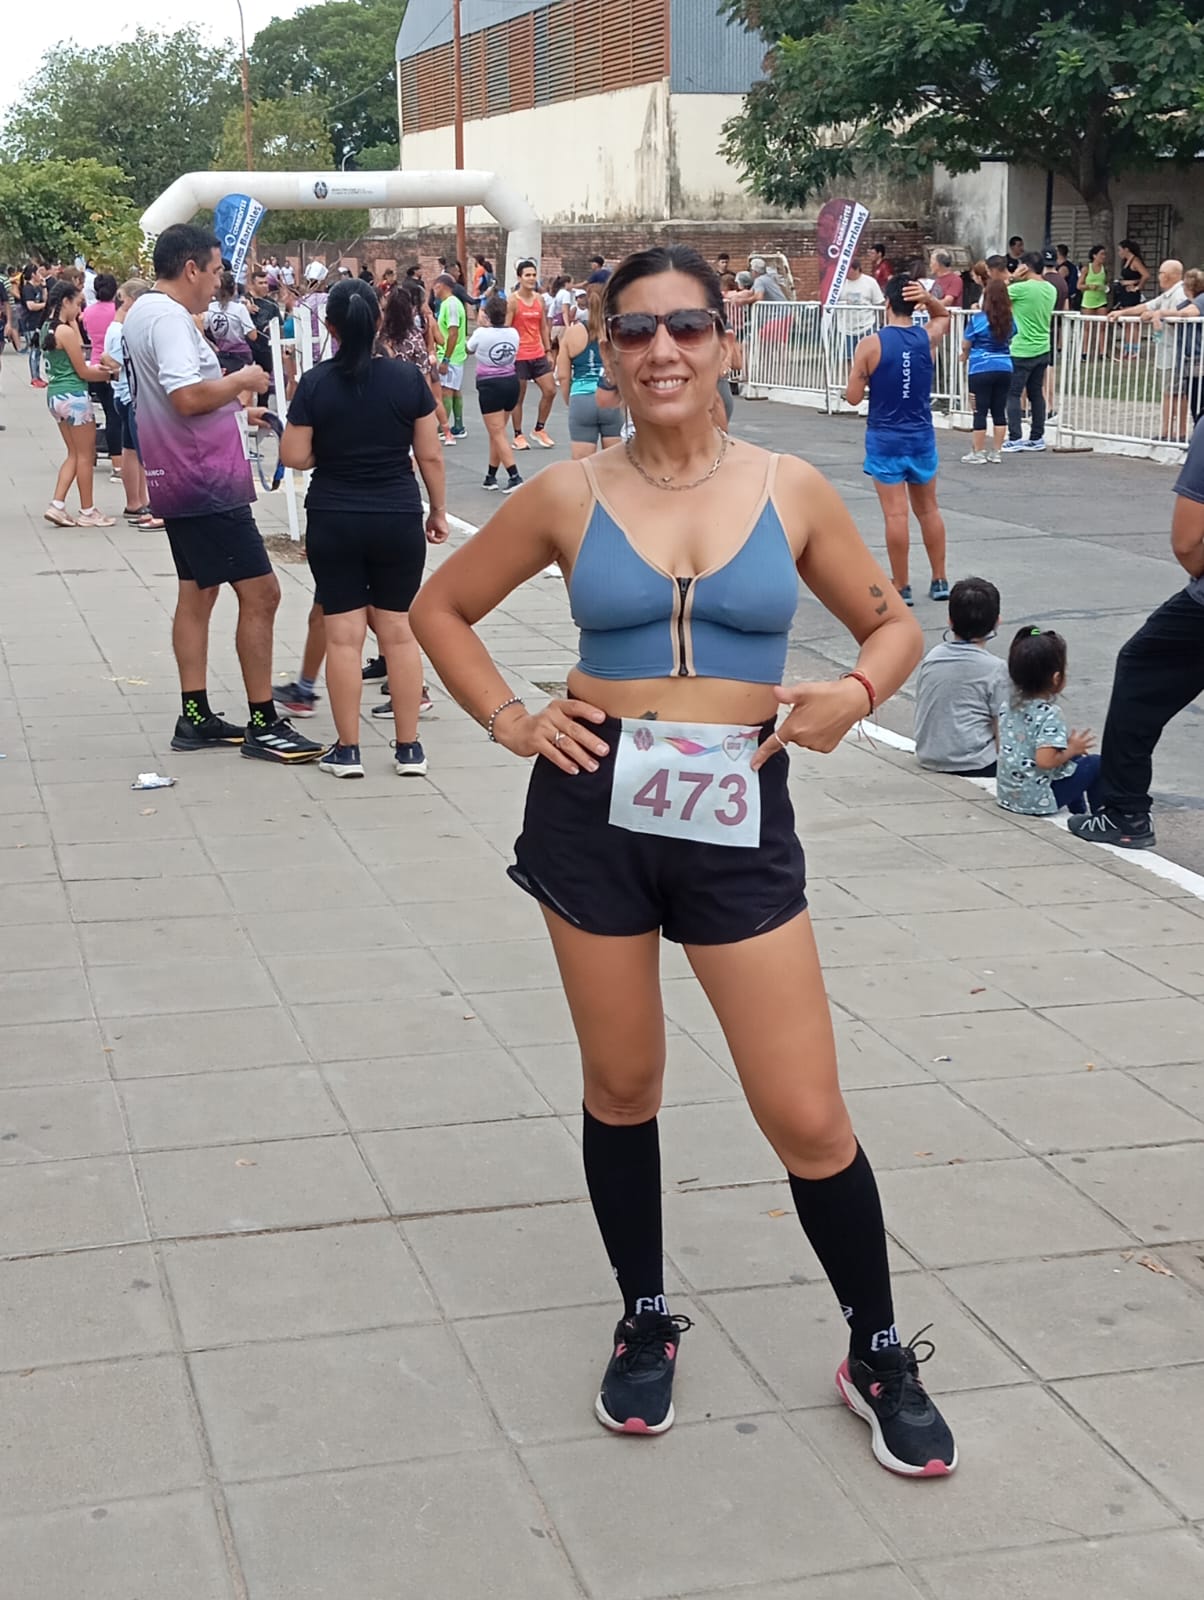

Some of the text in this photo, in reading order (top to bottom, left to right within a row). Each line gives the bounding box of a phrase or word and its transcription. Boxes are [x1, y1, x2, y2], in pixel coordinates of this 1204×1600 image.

[240, 205, 262, 246] Barriales
[826, 210, 867, 314] aratones Barriales
[902, 351, 911, 399] MALGOR
[632, 767, 749, 827] 473
